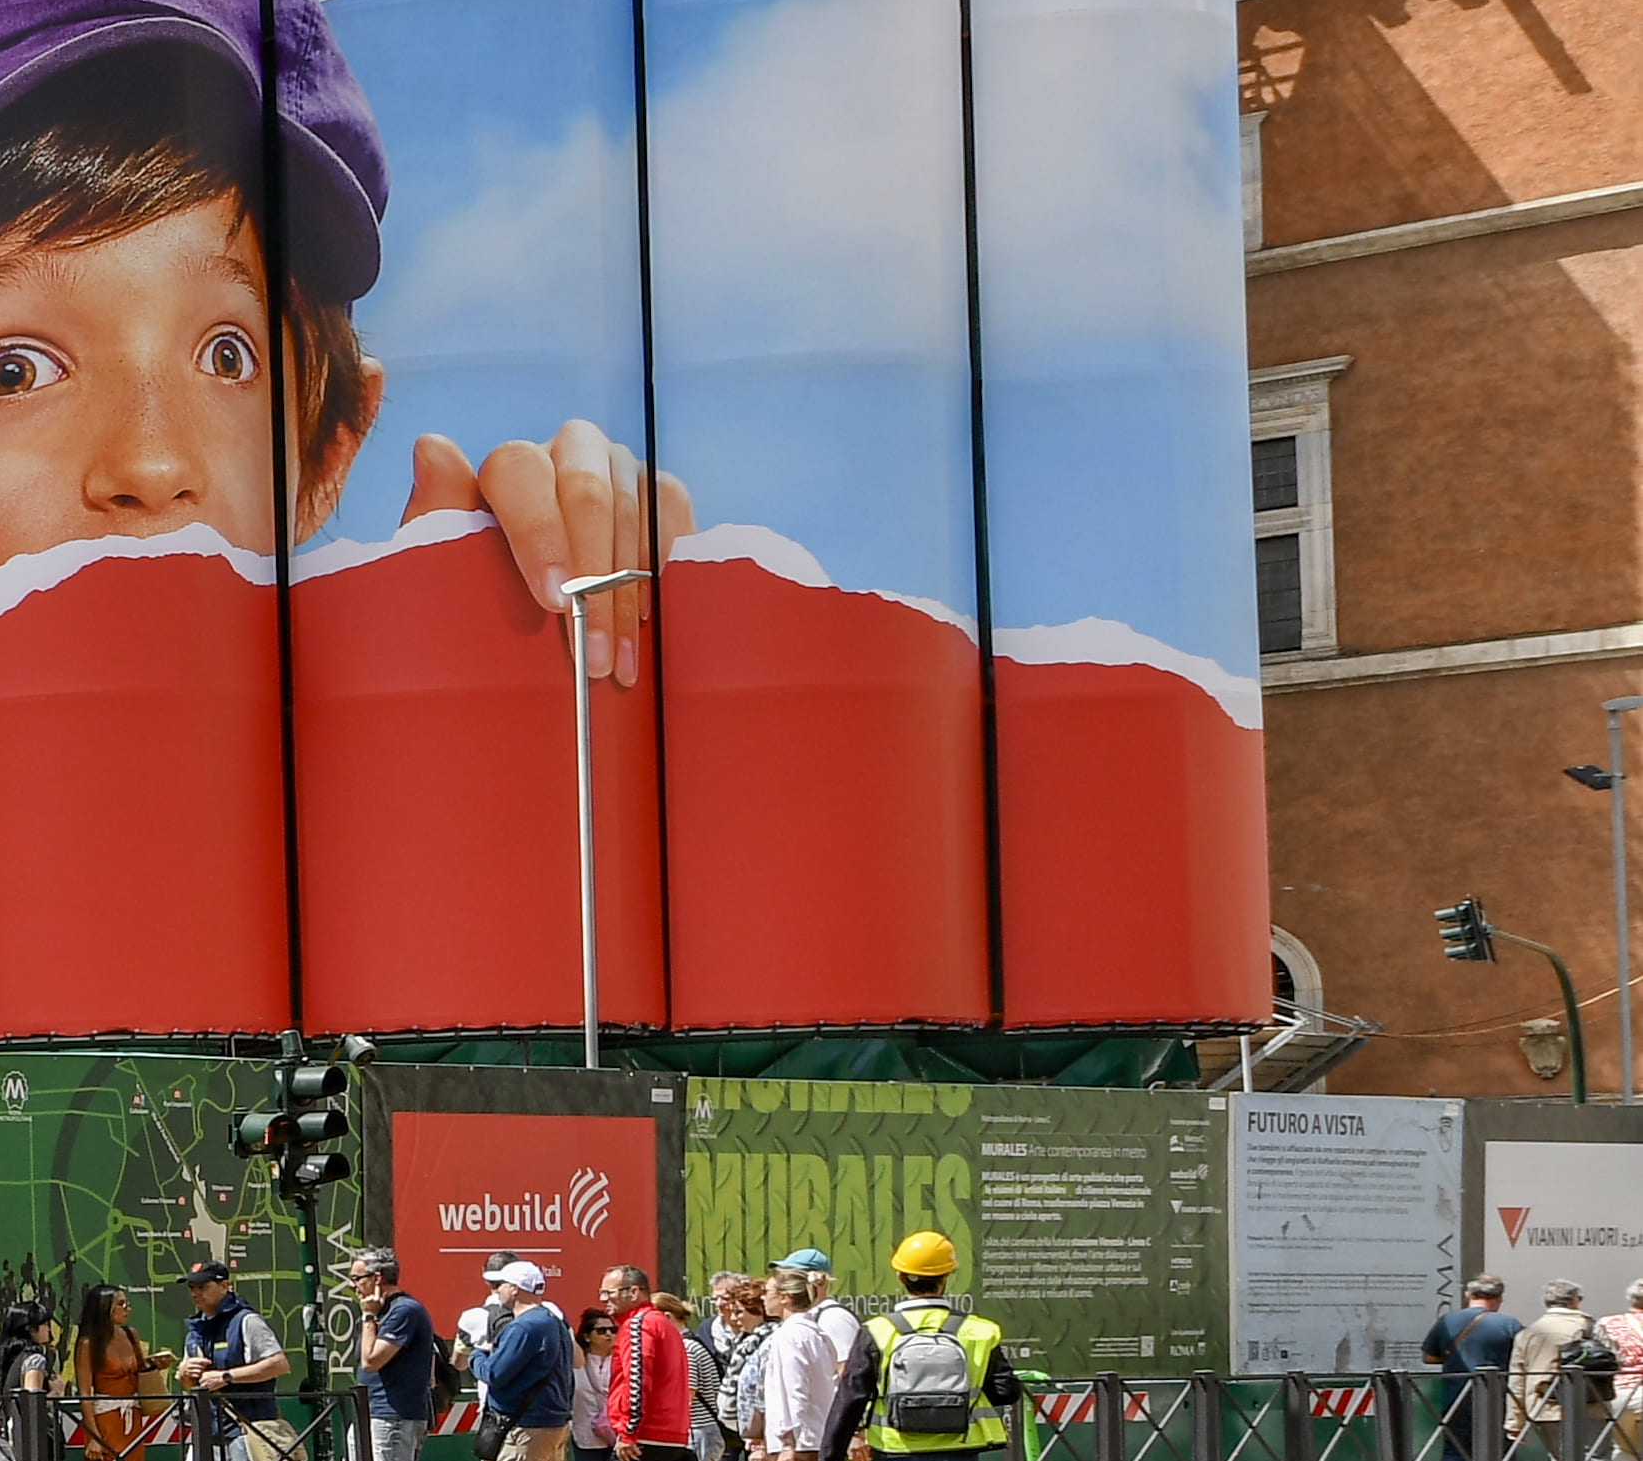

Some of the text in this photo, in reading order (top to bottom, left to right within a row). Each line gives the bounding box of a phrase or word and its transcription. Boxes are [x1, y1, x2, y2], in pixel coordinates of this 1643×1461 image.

[1247, 1111, 1366, 1136] FUTURO A VISTA
[981, 1143, 1028, 1157] MURALES
[438, 1191, 562, 1233] webuild
[684, 1152, 973, 1297] MURALES
[1527, 1227, 1573, 1246] VIANINI
[1577, 1226, 1618, 1247] LAVORI
[327, 1221, 354, 1375] ROMA
